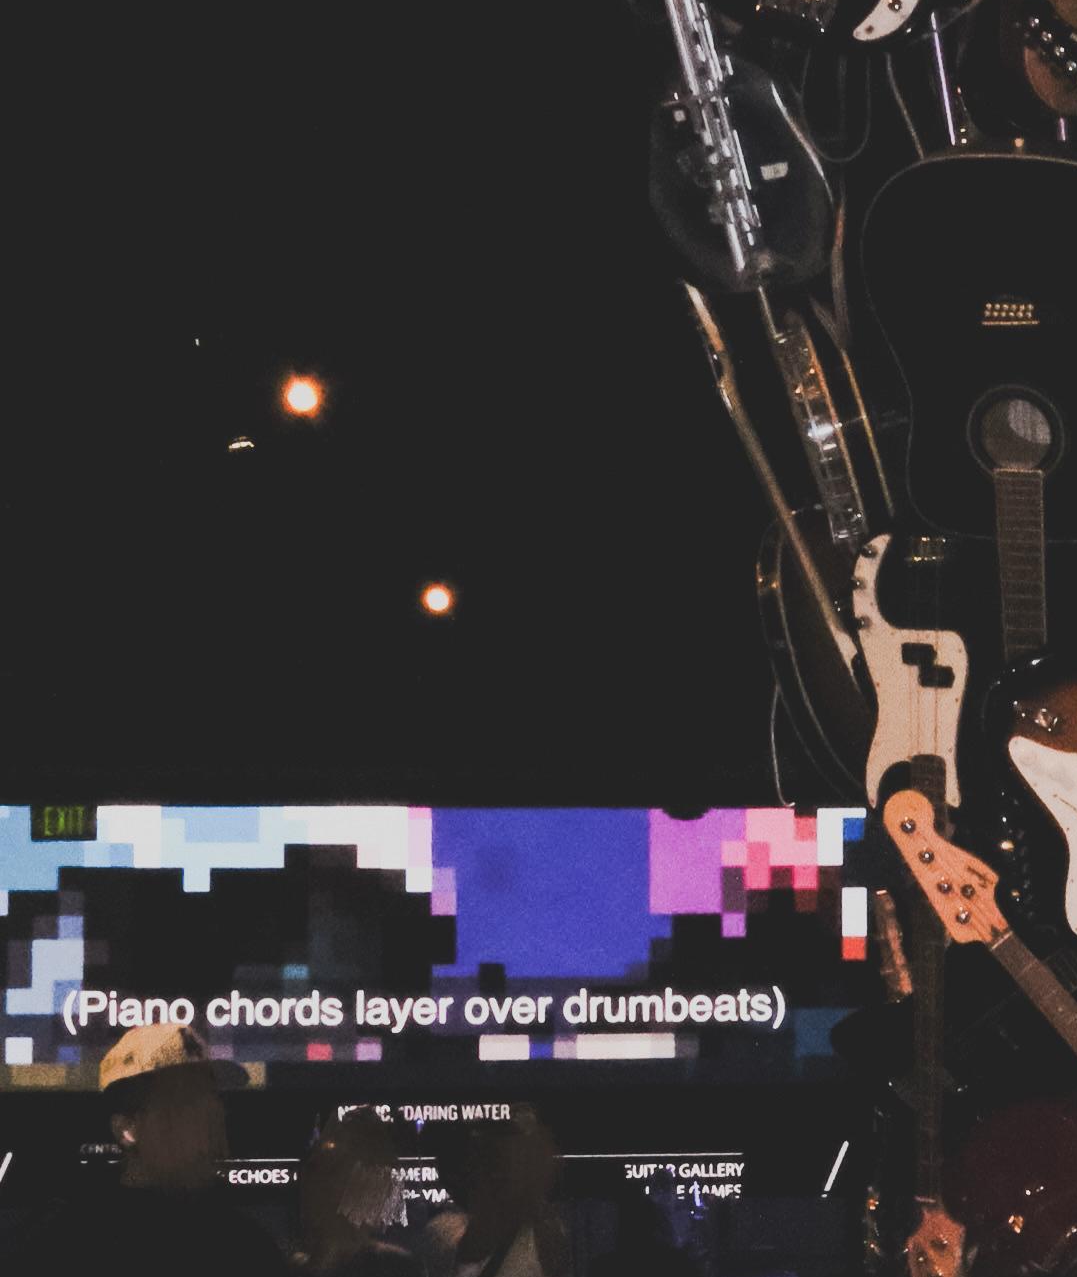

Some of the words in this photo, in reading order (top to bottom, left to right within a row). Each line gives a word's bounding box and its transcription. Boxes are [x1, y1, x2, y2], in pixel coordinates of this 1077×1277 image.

[44, 805, 85, 836] EXIT
[63, 990, 195, 1035] (Piano
[206, 989, 344, 1026] chords
[356, 989, 453, 1034] layer
[464, 995, 552, 1025] over
[563, 986, 786, 1030] drumbeats)
[461, 1103, 511, 1121] WATER
[228, 1168, 290, 1185] ECHOES
[678, 1162, 745, 1178] GALLERY
